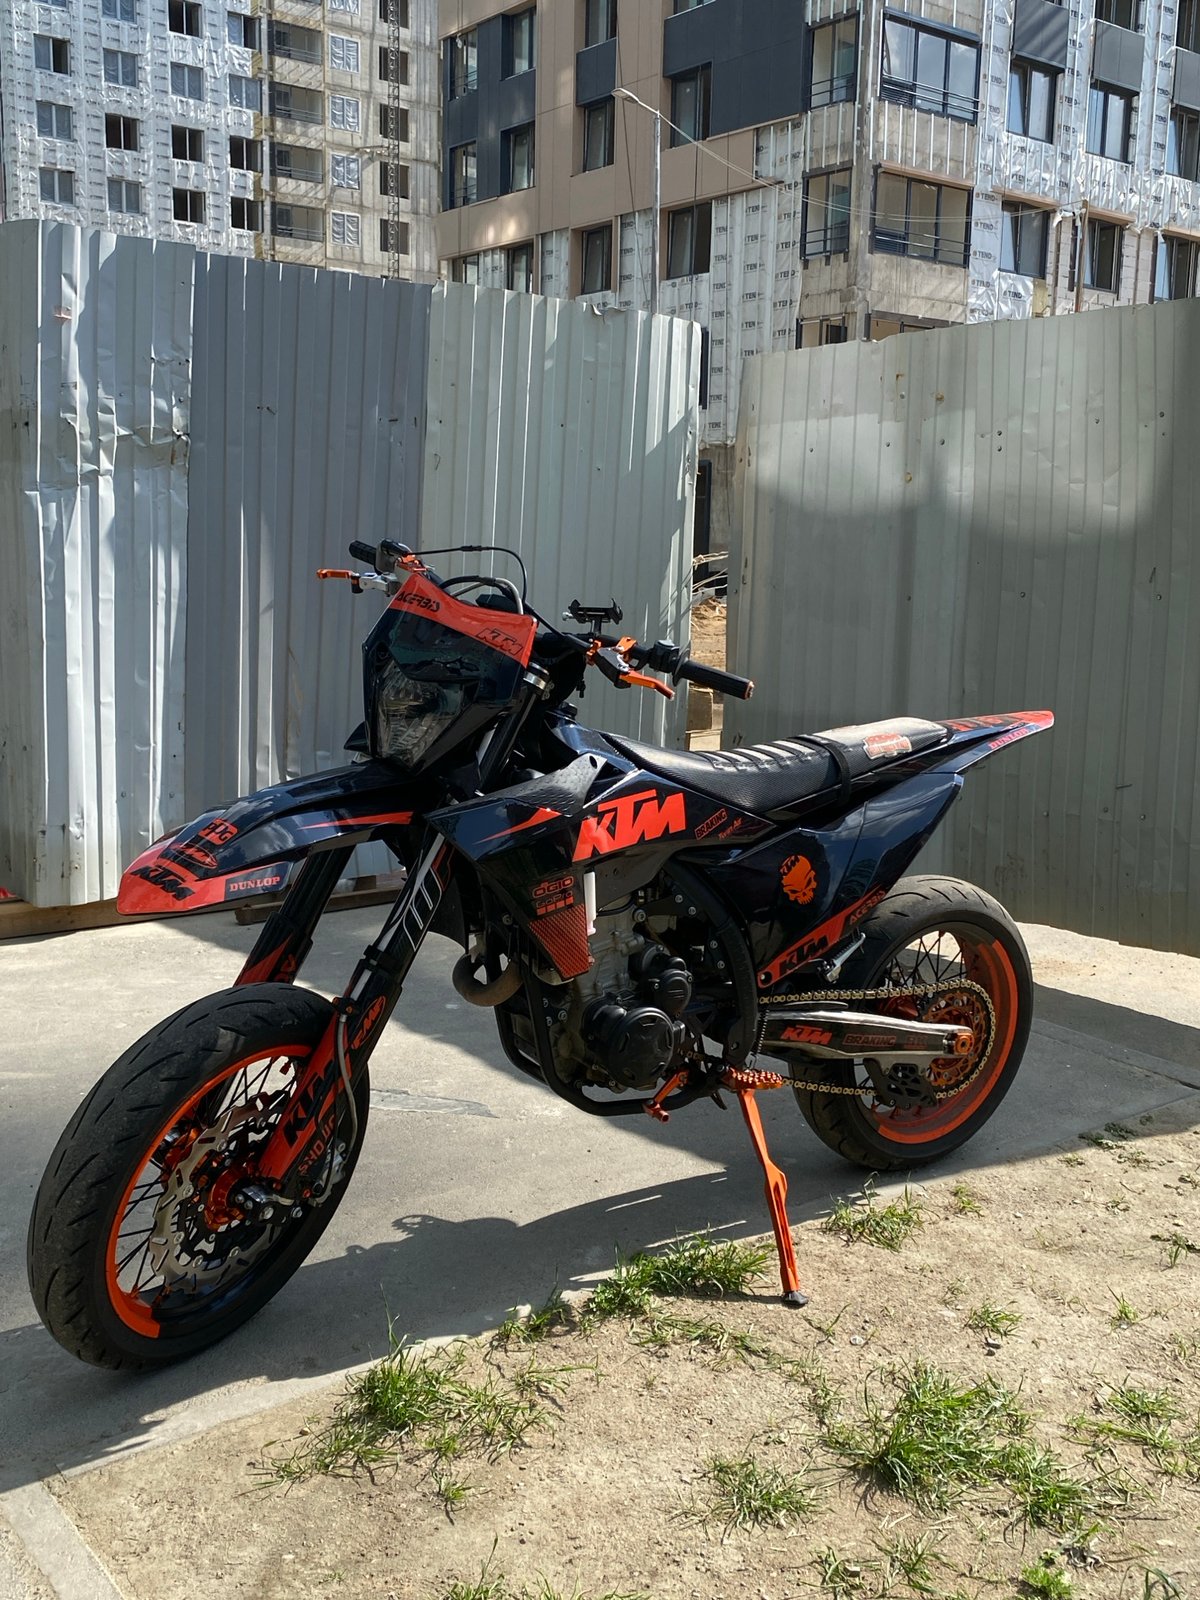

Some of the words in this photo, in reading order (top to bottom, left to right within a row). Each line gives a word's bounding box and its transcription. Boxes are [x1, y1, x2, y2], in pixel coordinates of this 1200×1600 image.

[1070, 10, 1084, 20] TED
[1069, 39, 1083, 49] TED
[1067, 68, 1080, 78] TED
[1065, 96, 1078, 106] TED
[784, 181, 798, 191] TED
[981, 192, 996, 201] TEND
[979, 221, 994, 231] TEND
[978, 251, 992, 260] TEND
[1008, 290, 1022, 299] TEND
[396, 591, 441, 612] ACERBIS
[475, 627, 525, 655] KTM
[202, 821, 233, 842] PPG
[572, 789, 686, 862] KTM
[694, 808, 728, 841] BRAKING
[130, 865, 195, 901] KTM
[229, 876, 280, 892] DUNLOP
[532, 876, 574, 899] OGIO
[778, 935, 829, 972] KTM
[780, 1024, 833, 1045] KTM
[844, 1035, 896, 1047] BRAKING
